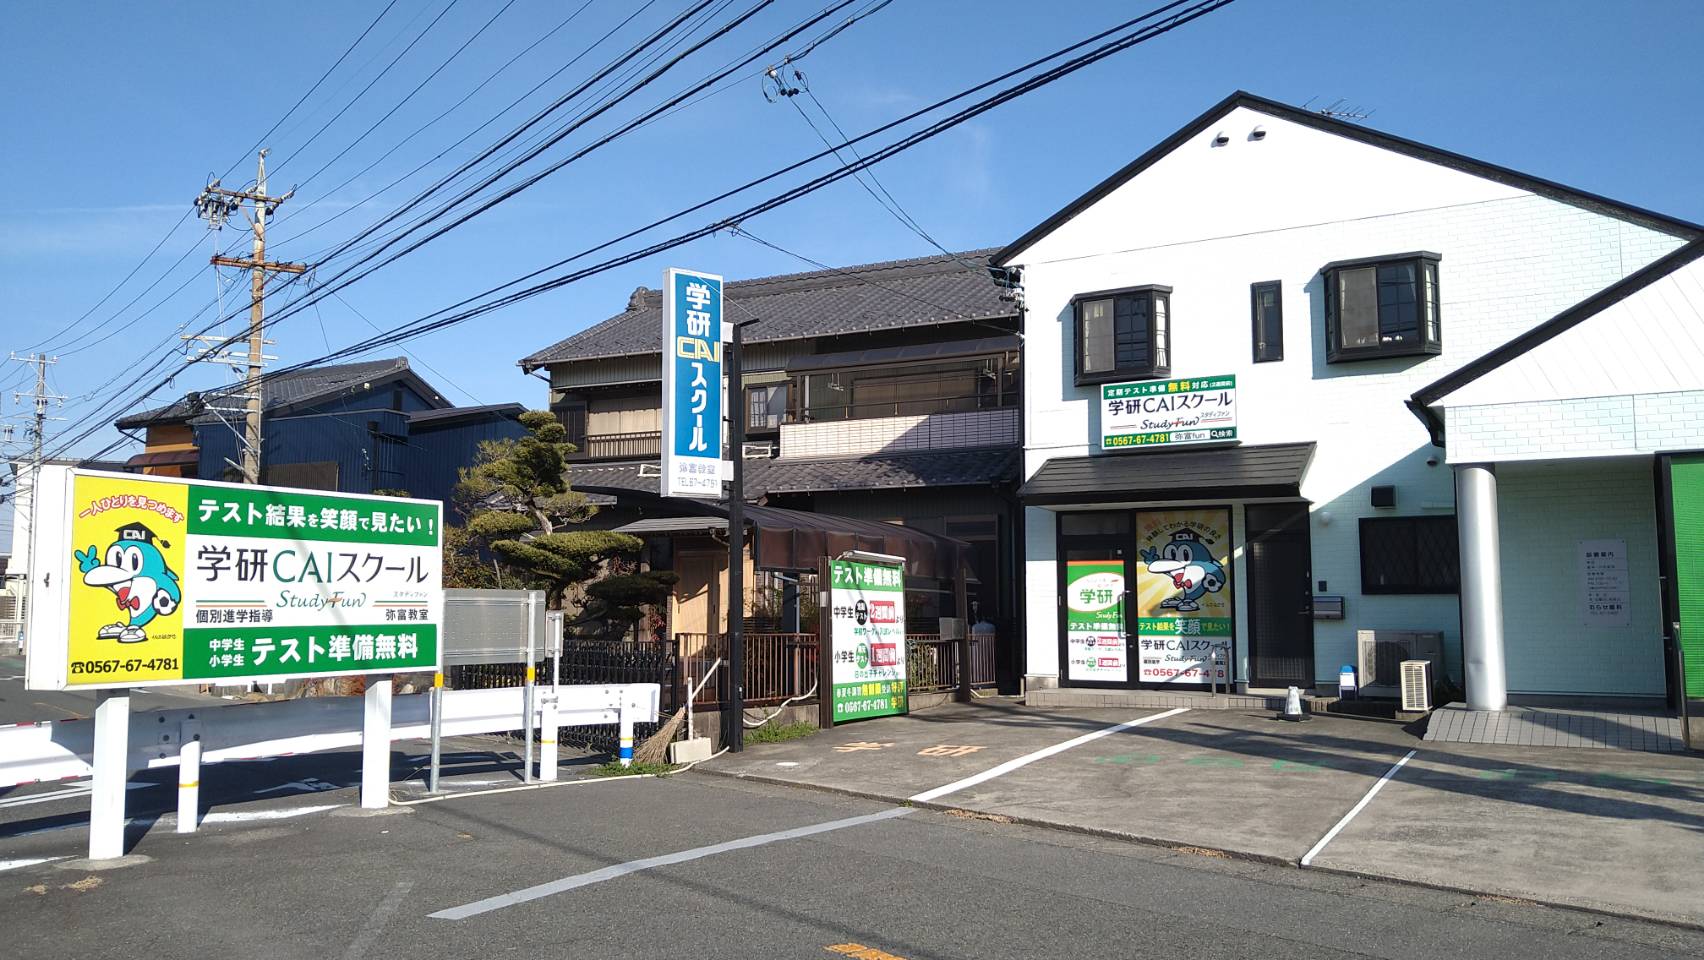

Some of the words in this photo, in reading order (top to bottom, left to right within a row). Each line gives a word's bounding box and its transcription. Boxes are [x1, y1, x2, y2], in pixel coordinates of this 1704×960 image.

[677, 282, 720, 452] 学研CAIスクール
[1108, 391, 1233, 416] 学研CAIスクール
[1113, 433, 1169, 446] 0567-67-4781
[79, 494, 185, 523] 一人ひとりを見つめます
[123, 529, 146, 540] CAI
[196, 545, 429, 583] 学研CAIスクール
[834, 565, 901, 587] テスト準備無料
[1080, 589, 1113, 604] 学研
[196, 609, 273, 623] 個別進学指導
[385, 608, 429, 621] 弥富教室
[834, 606, 854, 619] 中学生
[209, 638, 245, 652] 中学生
[251, 633, 418, 665] テスト準備無料
[1141, 640, 1231, 650] 学研CAIスクール
[209, 654, 245, 667] 小学生
[834, 650, 854, 663] 小学生
[85, 658, 179, 674] 0567-67-4781
